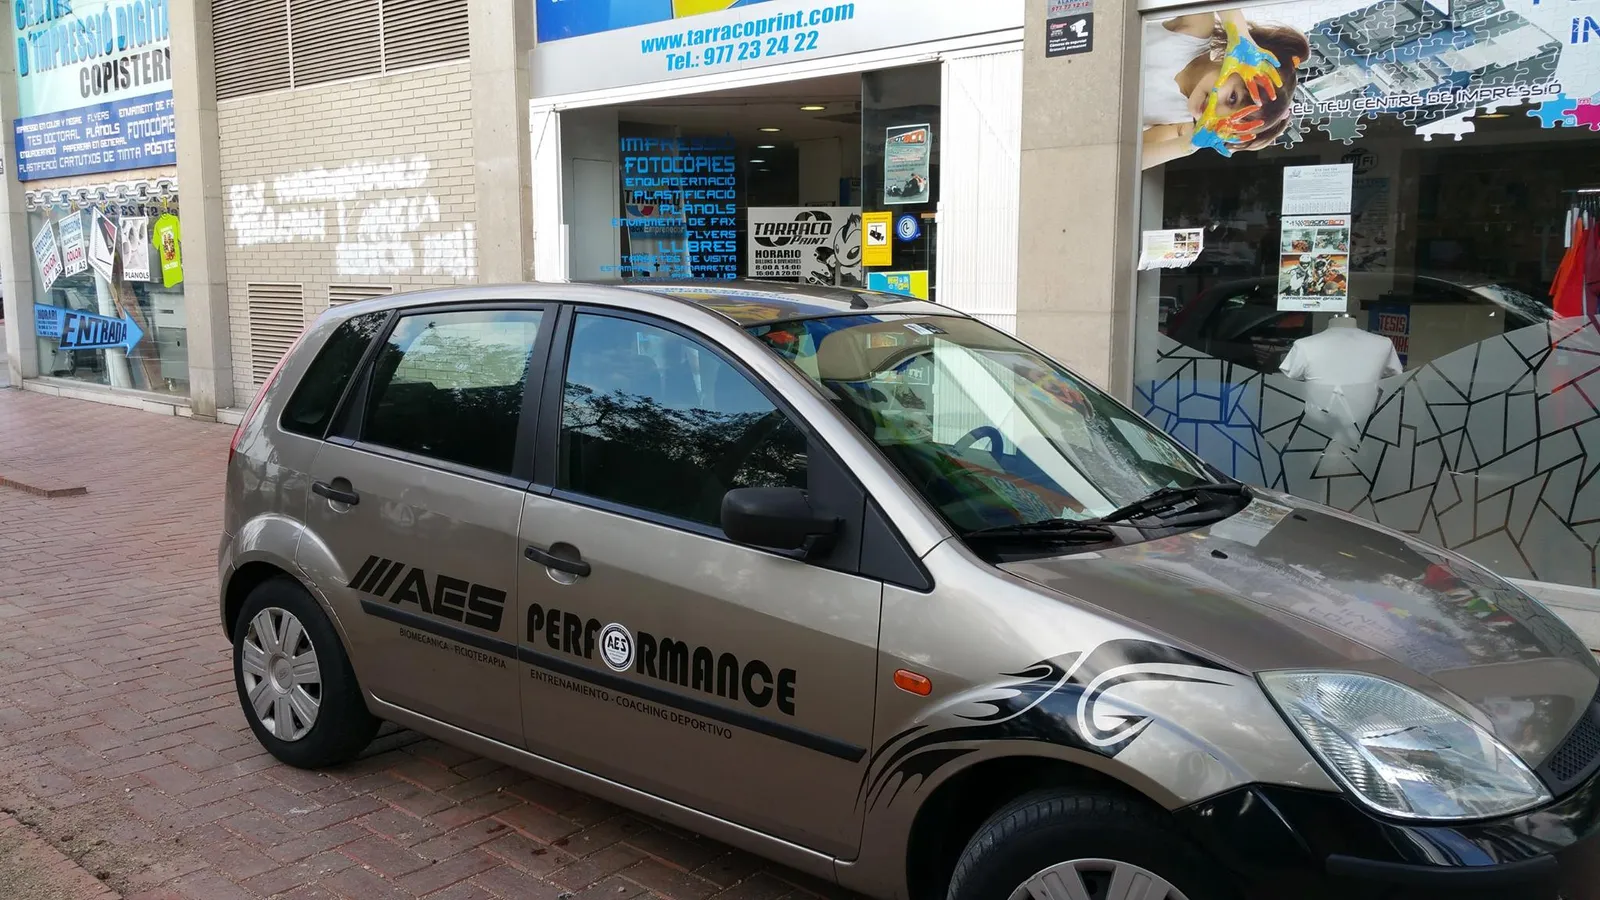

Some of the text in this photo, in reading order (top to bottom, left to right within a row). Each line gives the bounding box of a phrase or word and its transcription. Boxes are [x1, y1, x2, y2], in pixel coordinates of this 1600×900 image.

[641, 3, 855, 54] www.tarracoprint.com
[666, 30, 819, 71] Tel.: 977 23 24 22
[1292, 80, 1562, 116] EL TEU CENTRE DE IMPRESSIÓ
[87, 111, 110, 124] FLYERS
[155, 101, 165, 111] DE
[44, 128, 81, 144] DOCTORAL
[59, 151, 101, 168] CARTUTXOS
[103, 150, 115, 163] DE
[117, 147, 142, 161] TINTA
[625, 153, 736, 174] FOTOCÒPIES
[625, 174, 736, 187] ENQUADERNACIÓ
[634, 186, 736, 200] PLASTIFICACIÓ
[659, 201, 736, 215] PLÀNOLS
[688, 217, 706, 226] DE
[711, 217, 736, 226] FAX
[754, 222, 832, 236] TARRACO
[684, 230, 737, 239] FLYERS
[66, 247, 82, 262] COLOR
[704, 255, 737, 263] VISITA
[755, 249, 802, 259] HORARIO
[43, 254, 57, 277] COLOR
[78, 260, 86, 270] A3
[59, 312, 127, 348] ENTRADA
[1380, 315, 1406, 333] TESIS
[399, 627, 448, 650] BIOMECANICA
[454, 645, 507, 669] FICIOTERAPIA
[530, 668, 609, 702] ENTRENAMIENTO
[616, 695, 668, 721] COACHING
[670, 711, 732, 739] DEPORTIVO
